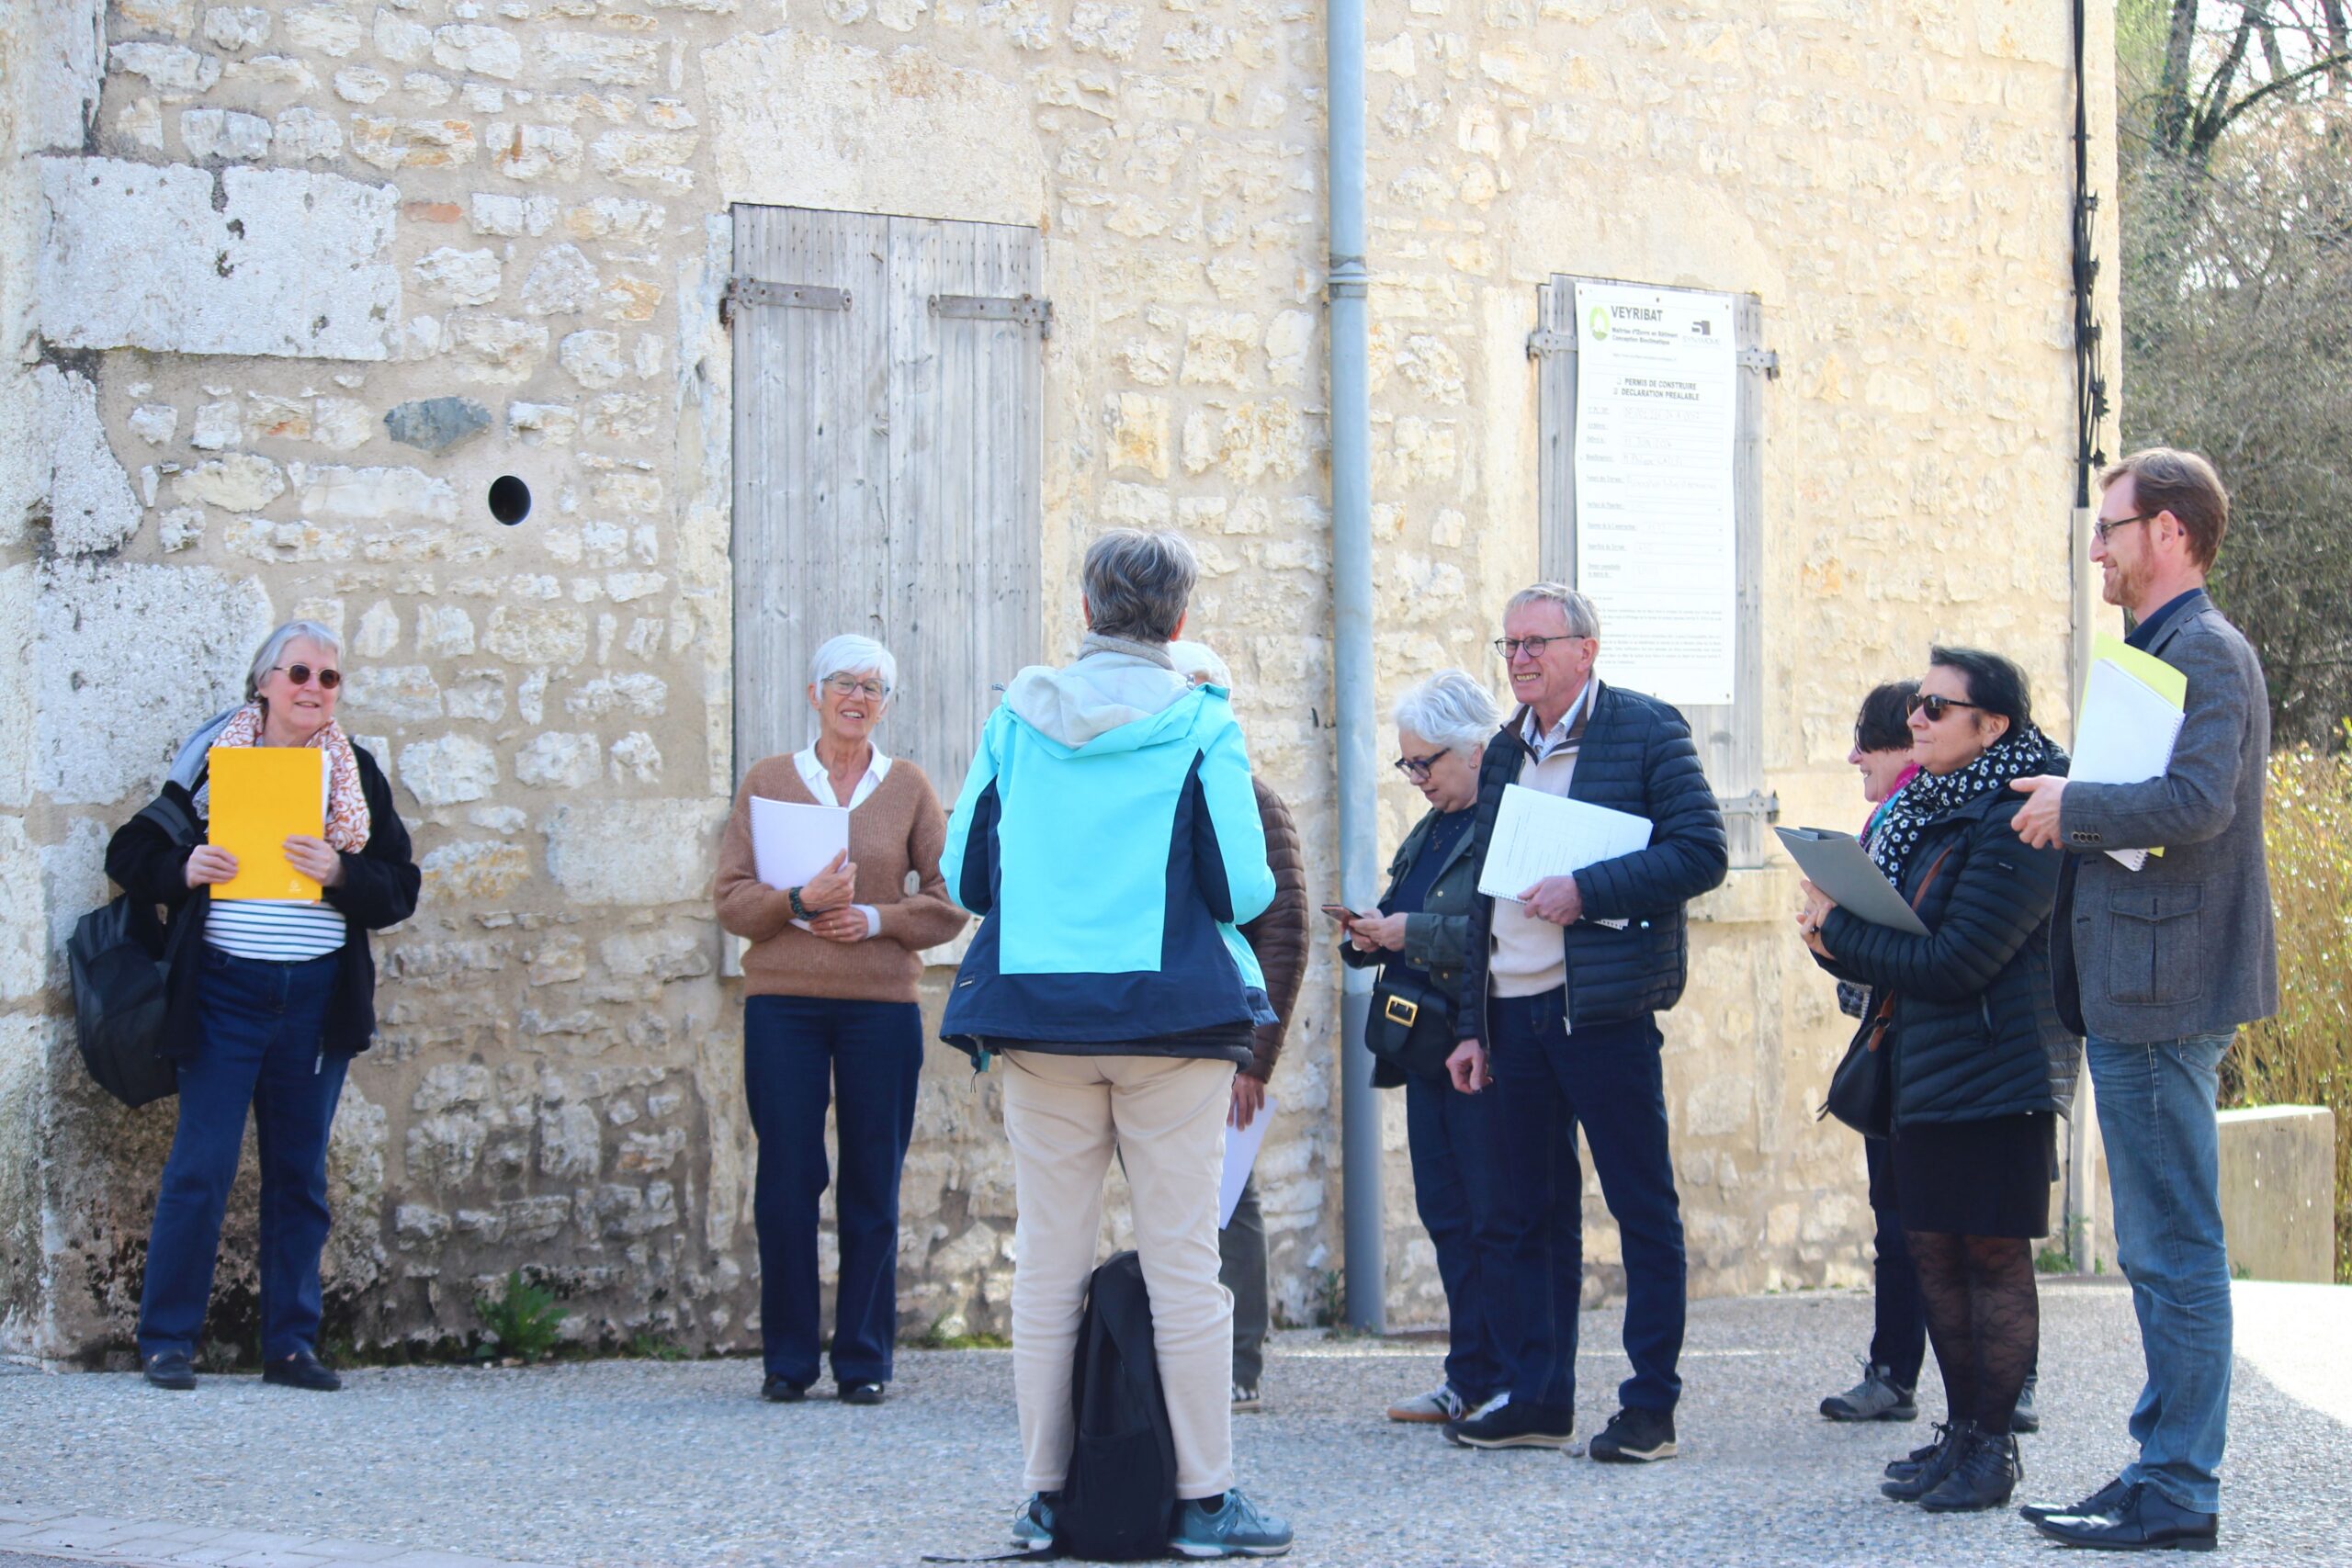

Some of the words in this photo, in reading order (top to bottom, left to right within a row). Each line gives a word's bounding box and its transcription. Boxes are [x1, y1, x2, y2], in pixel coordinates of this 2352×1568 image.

[1610, 305, 1664, 322] VEYRIBAT
[1624, 378, 1648, 387] PERMIS
[1649, 379, 1657, 388] DE
[1658, 380, 1697, 390] CONSTRUIRE
[1621, 388, 1664, 398] DECLARATION
[1665, 390, 1700, 401] PREALABLE
